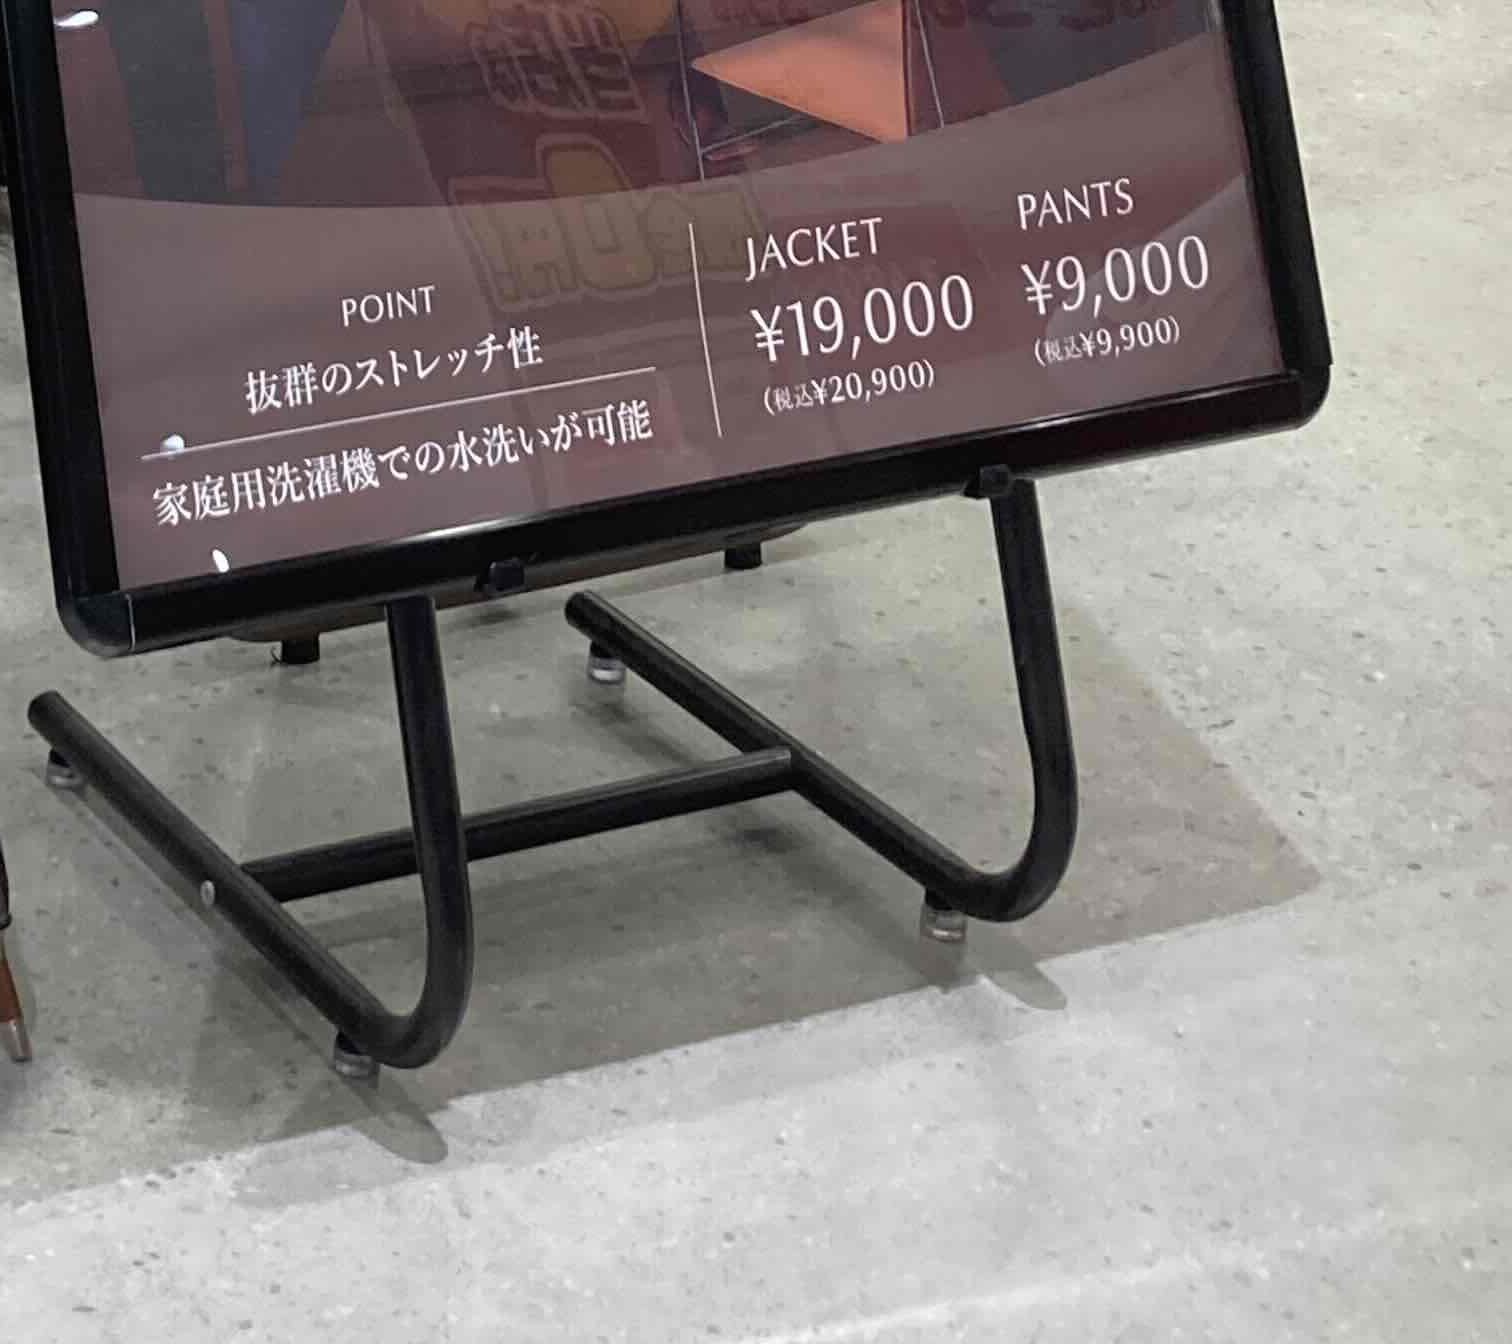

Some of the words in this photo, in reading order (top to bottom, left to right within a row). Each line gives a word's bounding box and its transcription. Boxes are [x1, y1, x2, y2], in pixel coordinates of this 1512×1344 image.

[1016, 178, 1134, 230] PANTS
[744, 217, 883, 282] JACKET
[1020, 235, 1209, 318] ¥9,000
[341, 286, 435, 326] POINT
[750, 274, 974, 362] ¥19,000
[245, 326, 543, 414] 抜群のストレッチ性
[153, 399, 653, 526] 家庭用洗濯機での水洗いが可能
